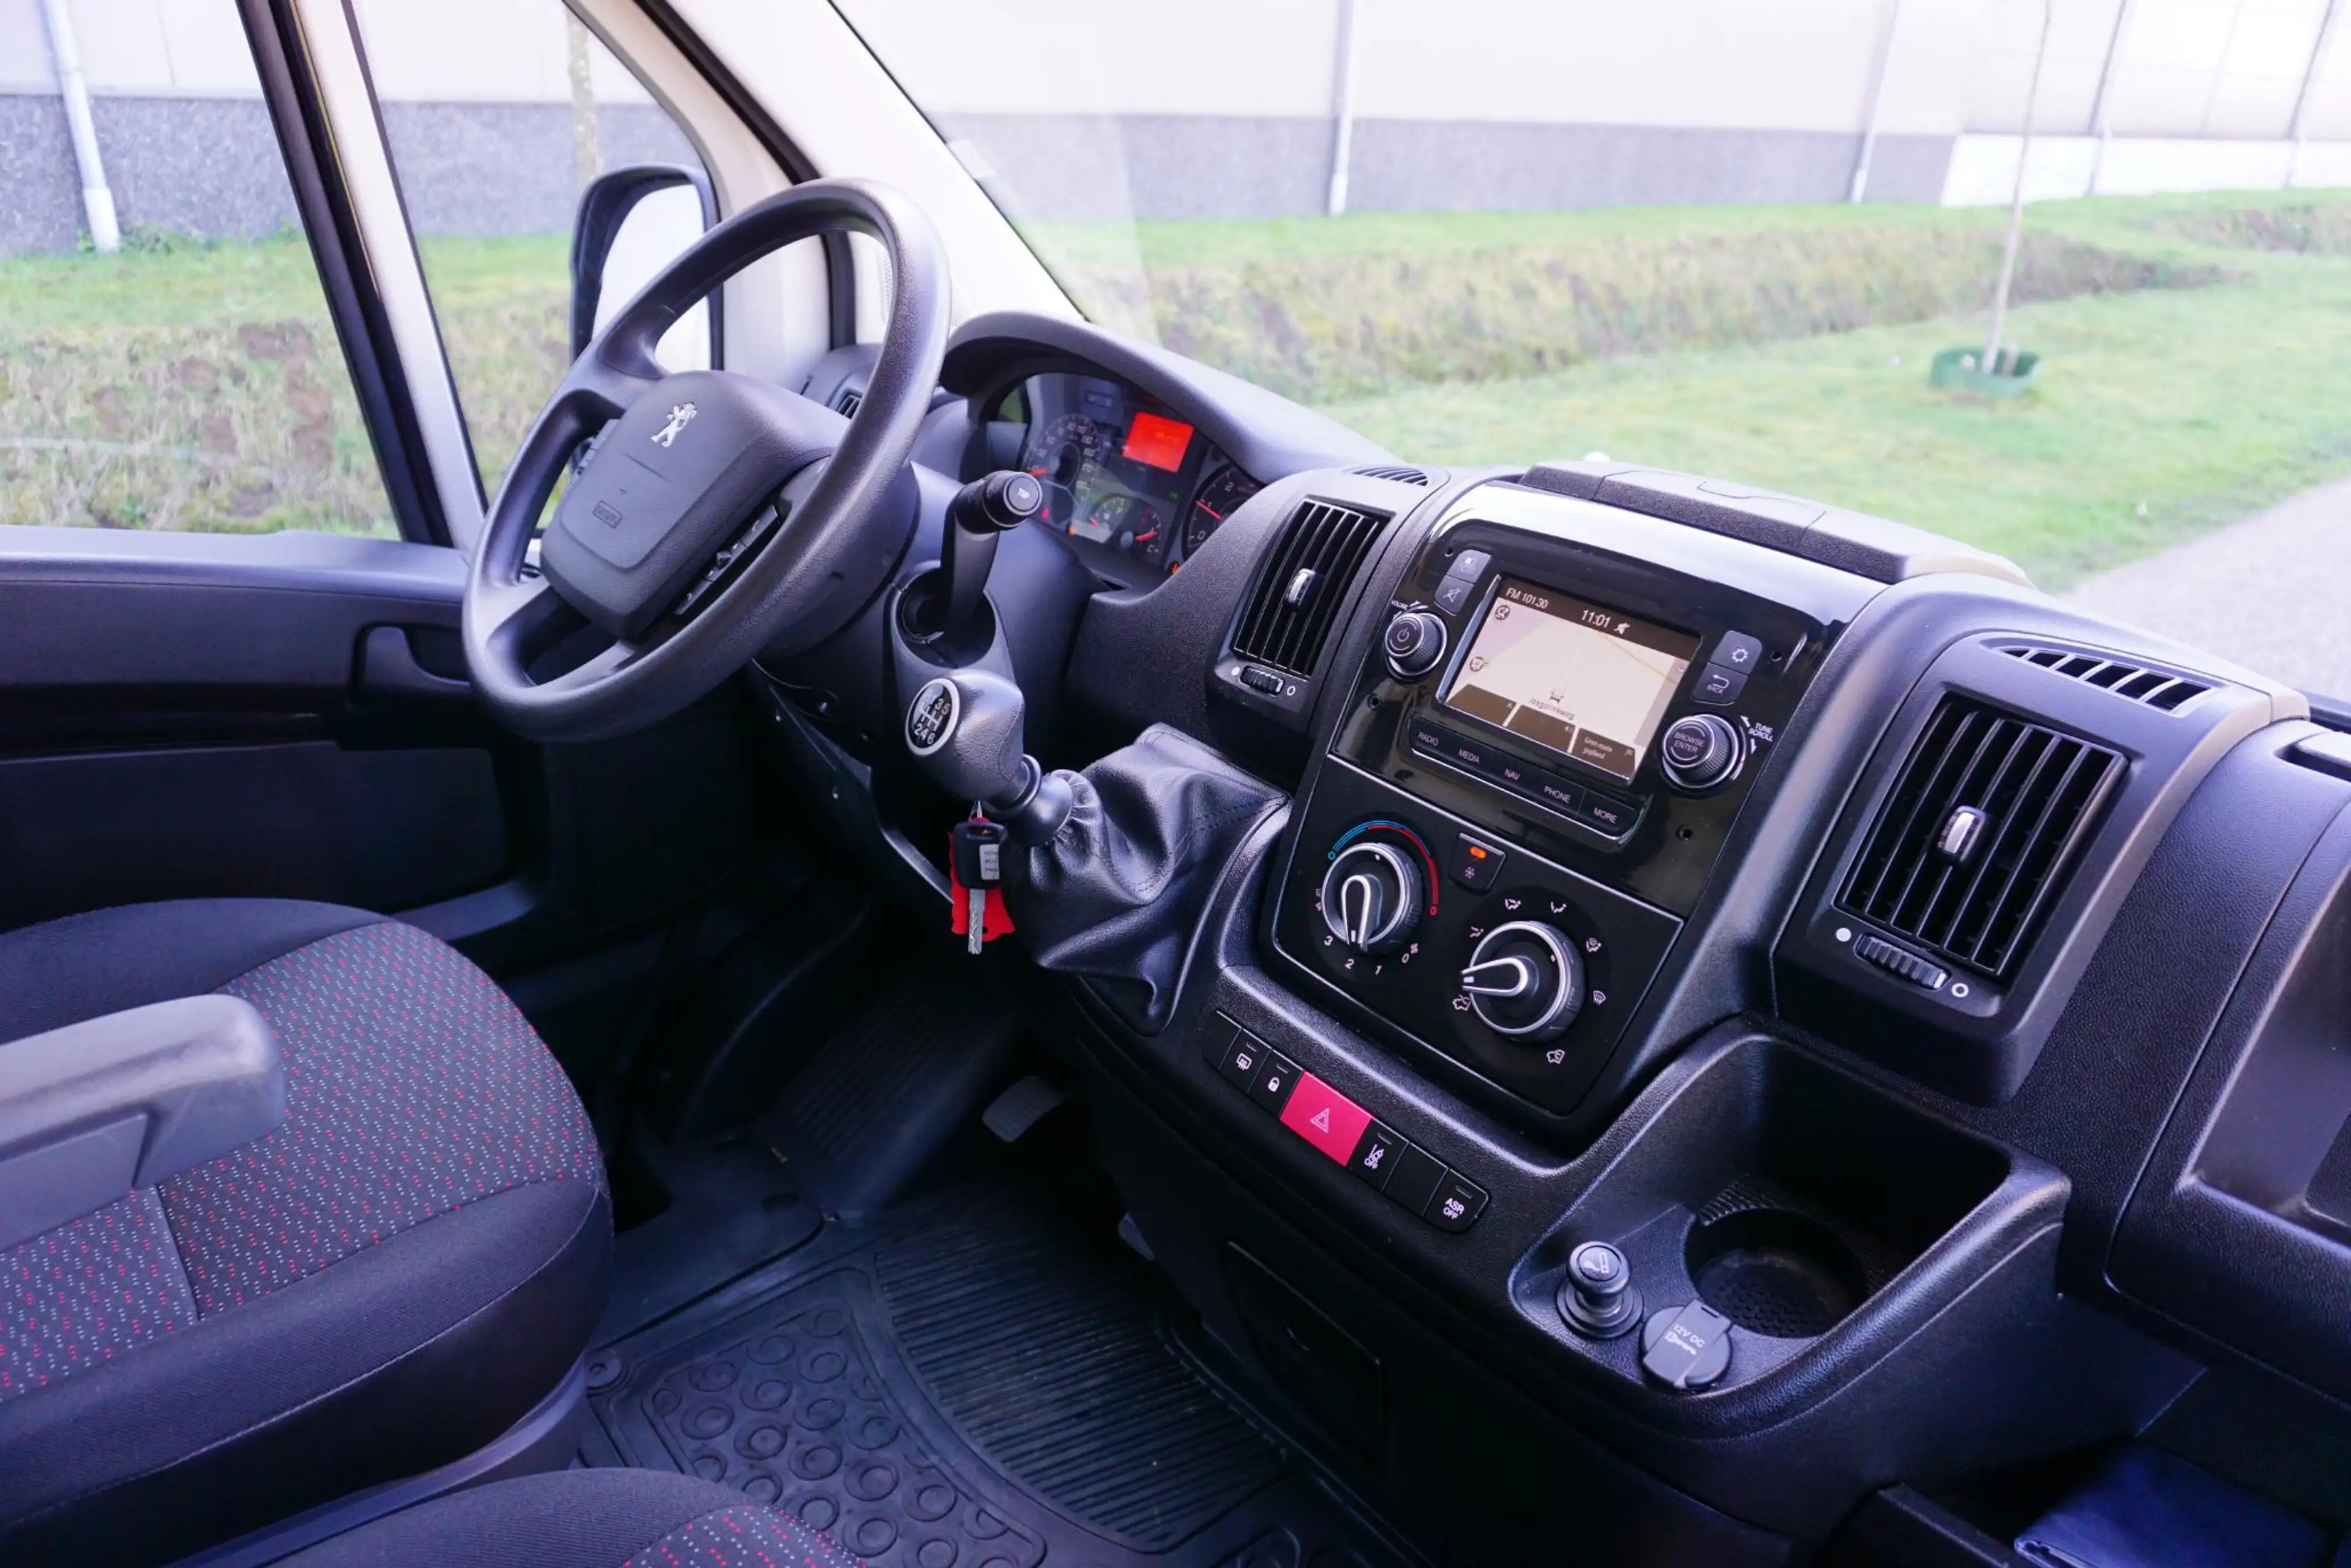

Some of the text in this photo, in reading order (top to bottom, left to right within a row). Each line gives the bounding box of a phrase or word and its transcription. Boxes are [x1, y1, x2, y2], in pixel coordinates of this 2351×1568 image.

[1224, 481, 1234, 492] 2
[1197, 530, 1205, 539] 0
[1506, 588, 1548, 609] FM 101.30
[1581, 609, 1611, 628] 11:01
[934, 698, 951, 715] 3 5
[914, 723, 936, 745] 2 4 6
[1749, 728, 1773, 742] SCROLL
[1755, 722, 1774, 734] TUNE
[1418, 732, 1439, 746] RADIO
[1674, 732, 1706, 747] BROWSE
[1674, 740, 1698, 754] ENTER
[1458, 749, 1479, 764] MEDIA
[1504, 768, 1521, 781] NAV
[1543, 786, 1572, 804] PHONE
[1593, 808, 1618, 824] MORE
[1324, 936, 1333, 945] 3
[1344, 958, 1354, 970] 2
[1401, 953, 1409, 964] 0
[1375, 965, 1382, 975] 1
[1443, 1207, 1459, 1220] OFF
[1445, 1198, 1464, 1215] ASR
[1673, 1324, 1705, 1348] 12V DC
